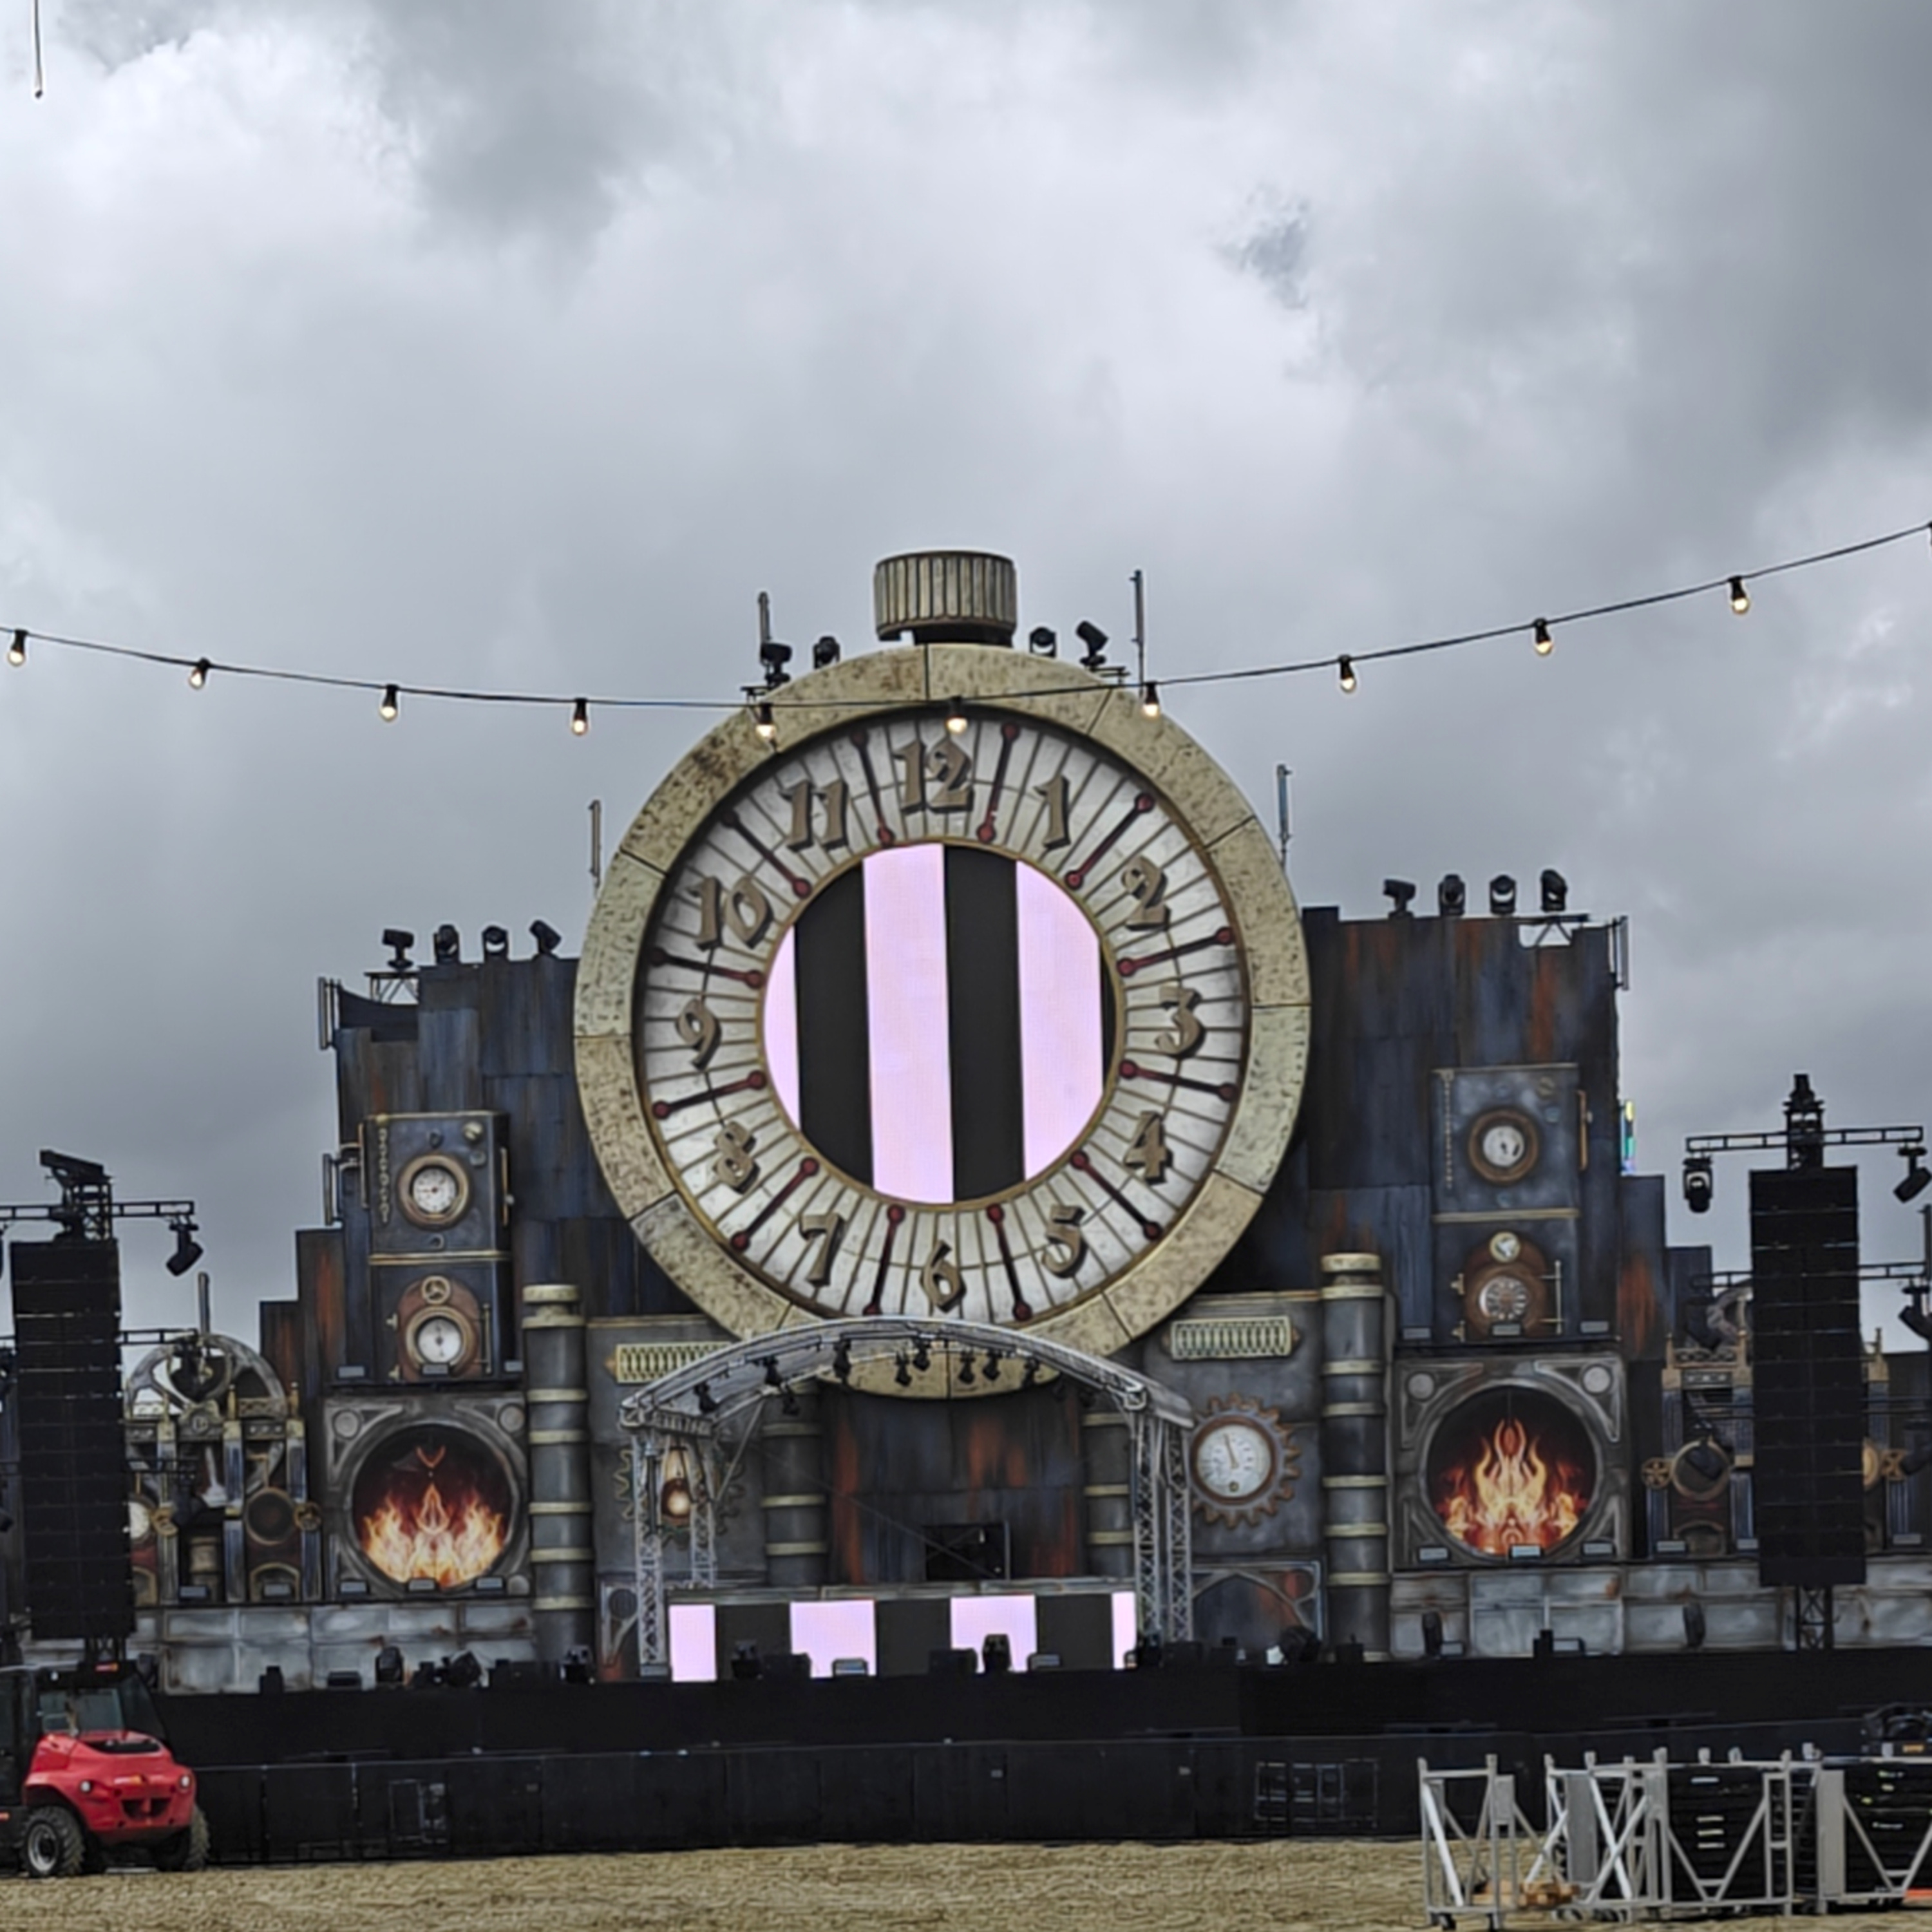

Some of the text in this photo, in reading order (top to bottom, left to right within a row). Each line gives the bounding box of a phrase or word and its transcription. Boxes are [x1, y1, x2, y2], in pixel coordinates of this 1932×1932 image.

[894, 739, 973, 813] 12
[1034, 774, 1070, 851] 1
[779, 780, 848, 851] 11
[685, 875, 772, 951] 10
[1121, 856, 1170, 931] 2
[676, 998, 721, 1071] 9
[1155, 985, 1205, 1058] 3
[713, 1121, 760, 1194] 8
[1124, 1111, 1172, 1184] 4
[799, 1213, 847, 1286] 7
[920, 1240, 965, 1312] 6
[1042, 1206, 1087, 1278] 5
